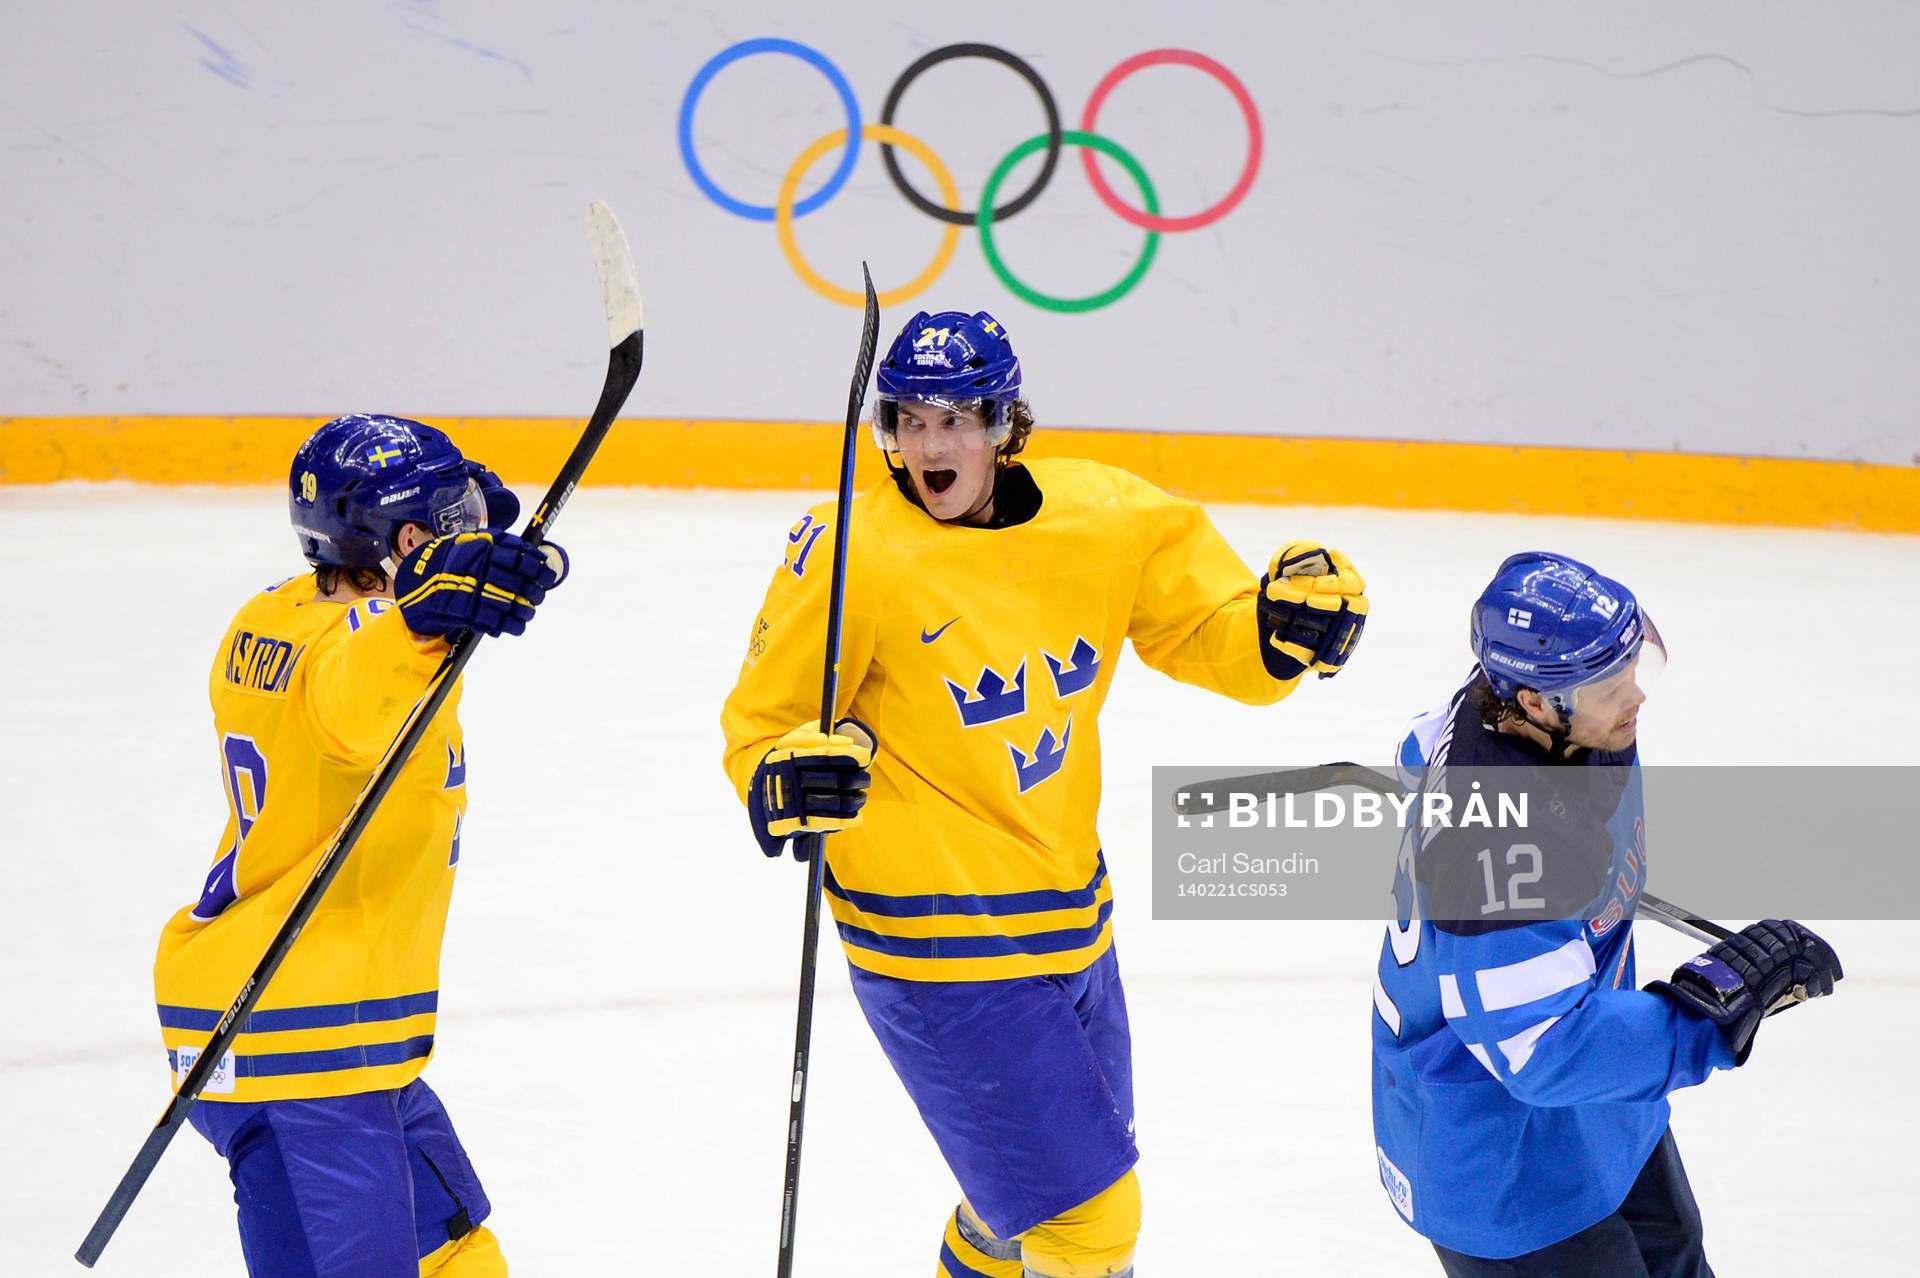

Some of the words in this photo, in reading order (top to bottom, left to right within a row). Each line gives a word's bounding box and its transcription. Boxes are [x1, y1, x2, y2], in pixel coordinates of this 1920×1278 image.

[915, 327, 950, 347] 21
[300, 470, 317, 503] 19
[380, 486, 420, 506] BAUER
[1591, 594, 1619, 621] 12
[1490, 651, 1537, 672] BAUER
[1477, 843, 1546, 916] 12
